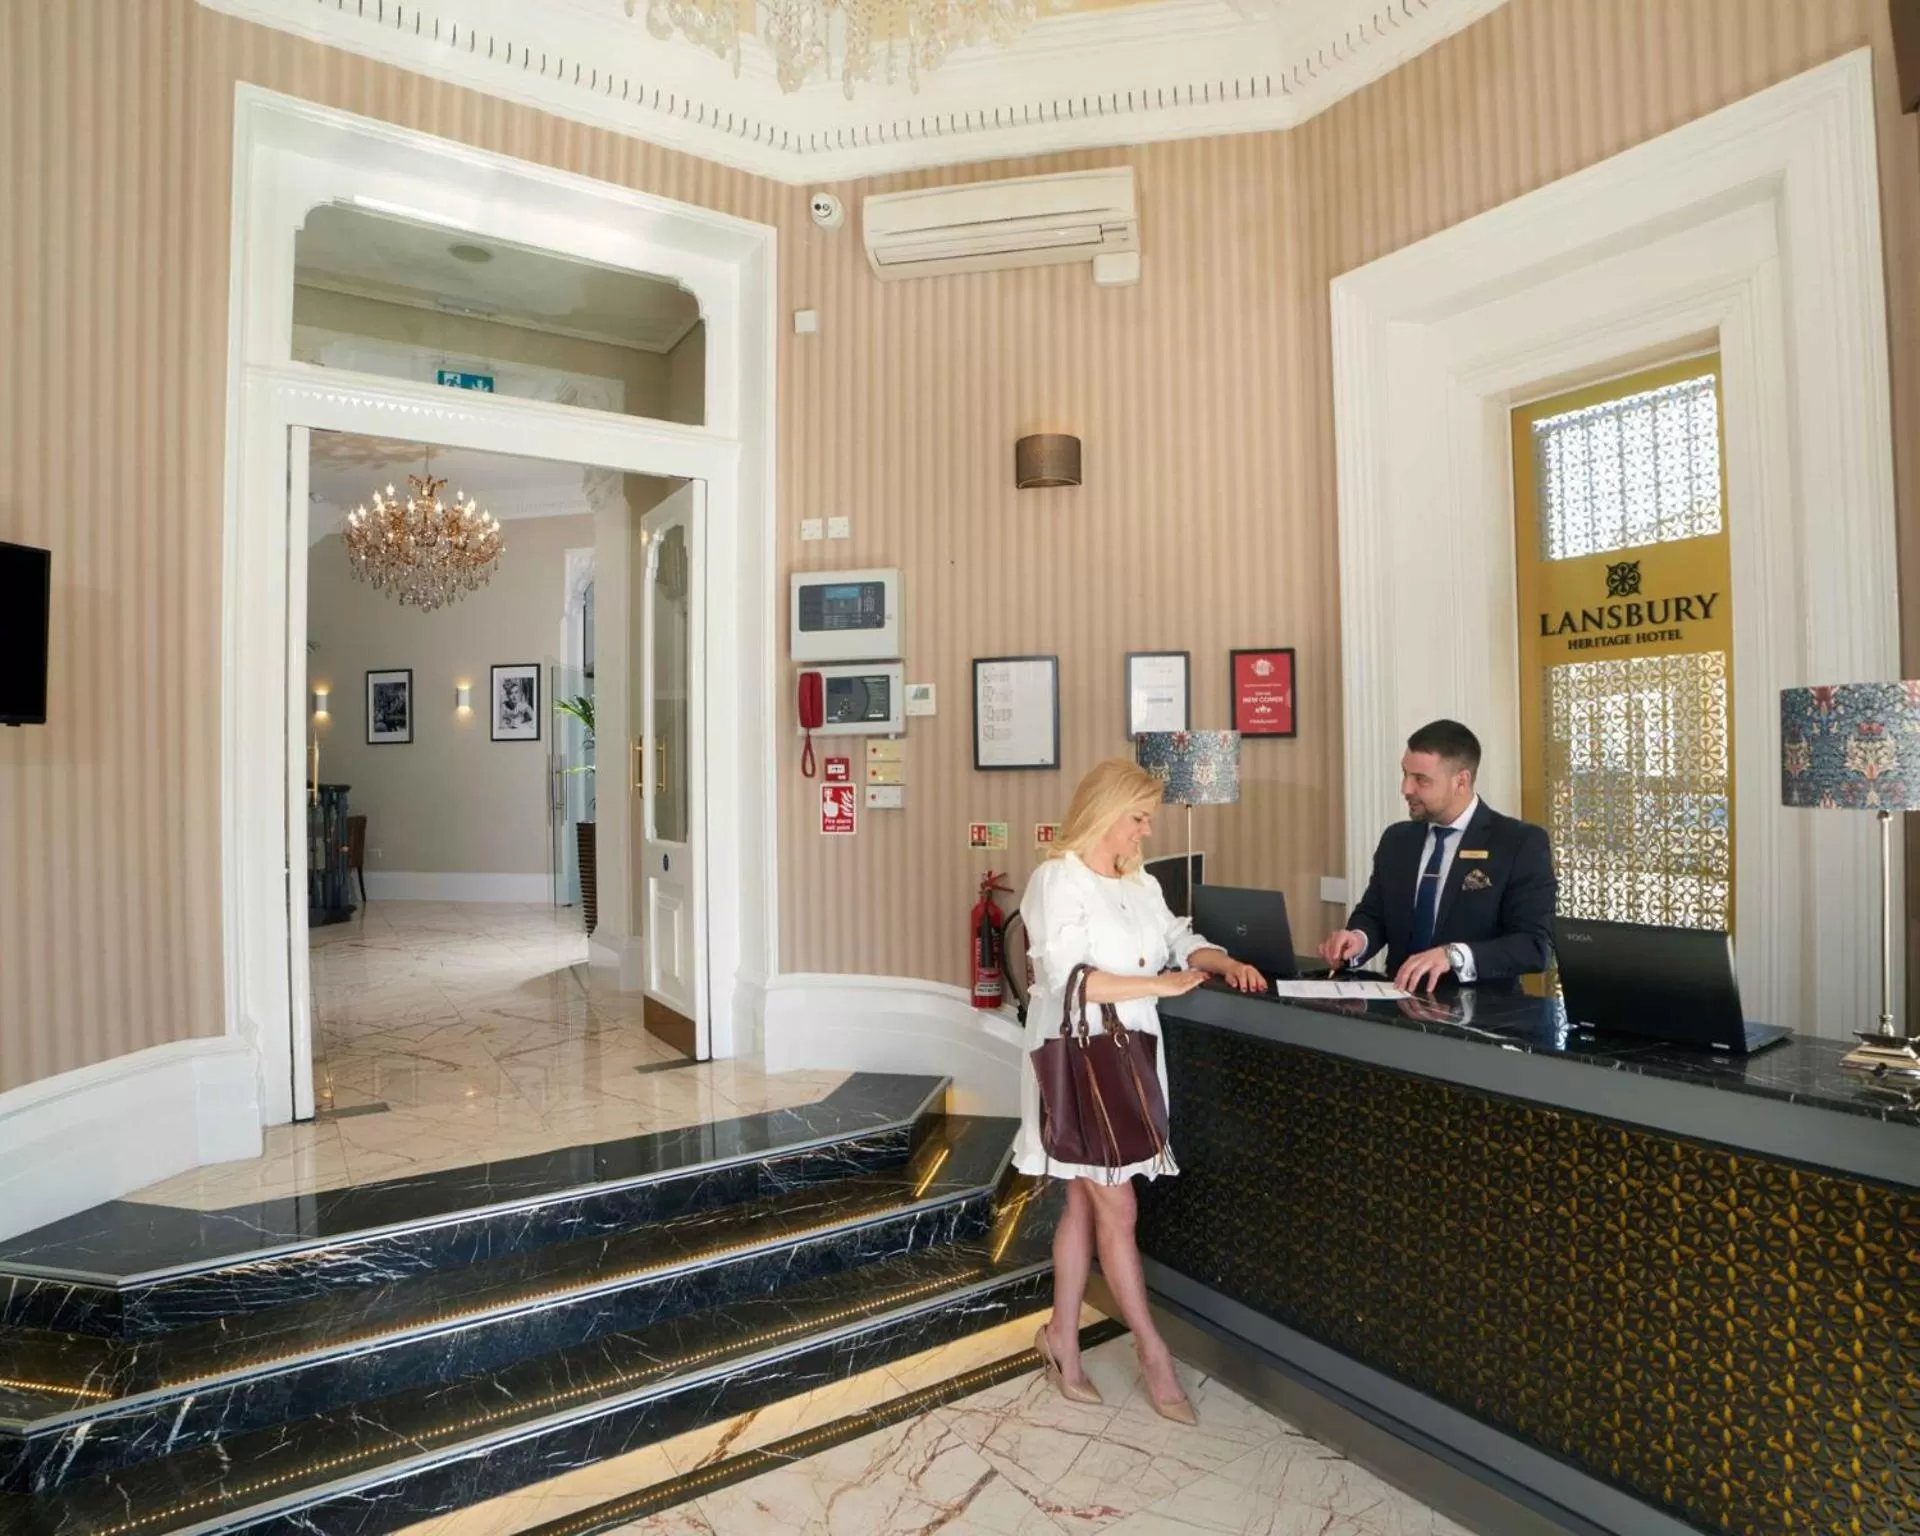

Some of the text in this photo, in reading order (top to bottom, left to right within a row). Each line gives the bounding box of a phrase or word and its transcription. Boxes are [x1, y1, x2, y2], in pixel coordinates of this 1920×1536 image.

[1540, 593, 1720, 637] LANSBURY
[1568, 628, 1684, 650] HERITAGE HOTEL
[1566, 932, 1593, 943] YOGA
